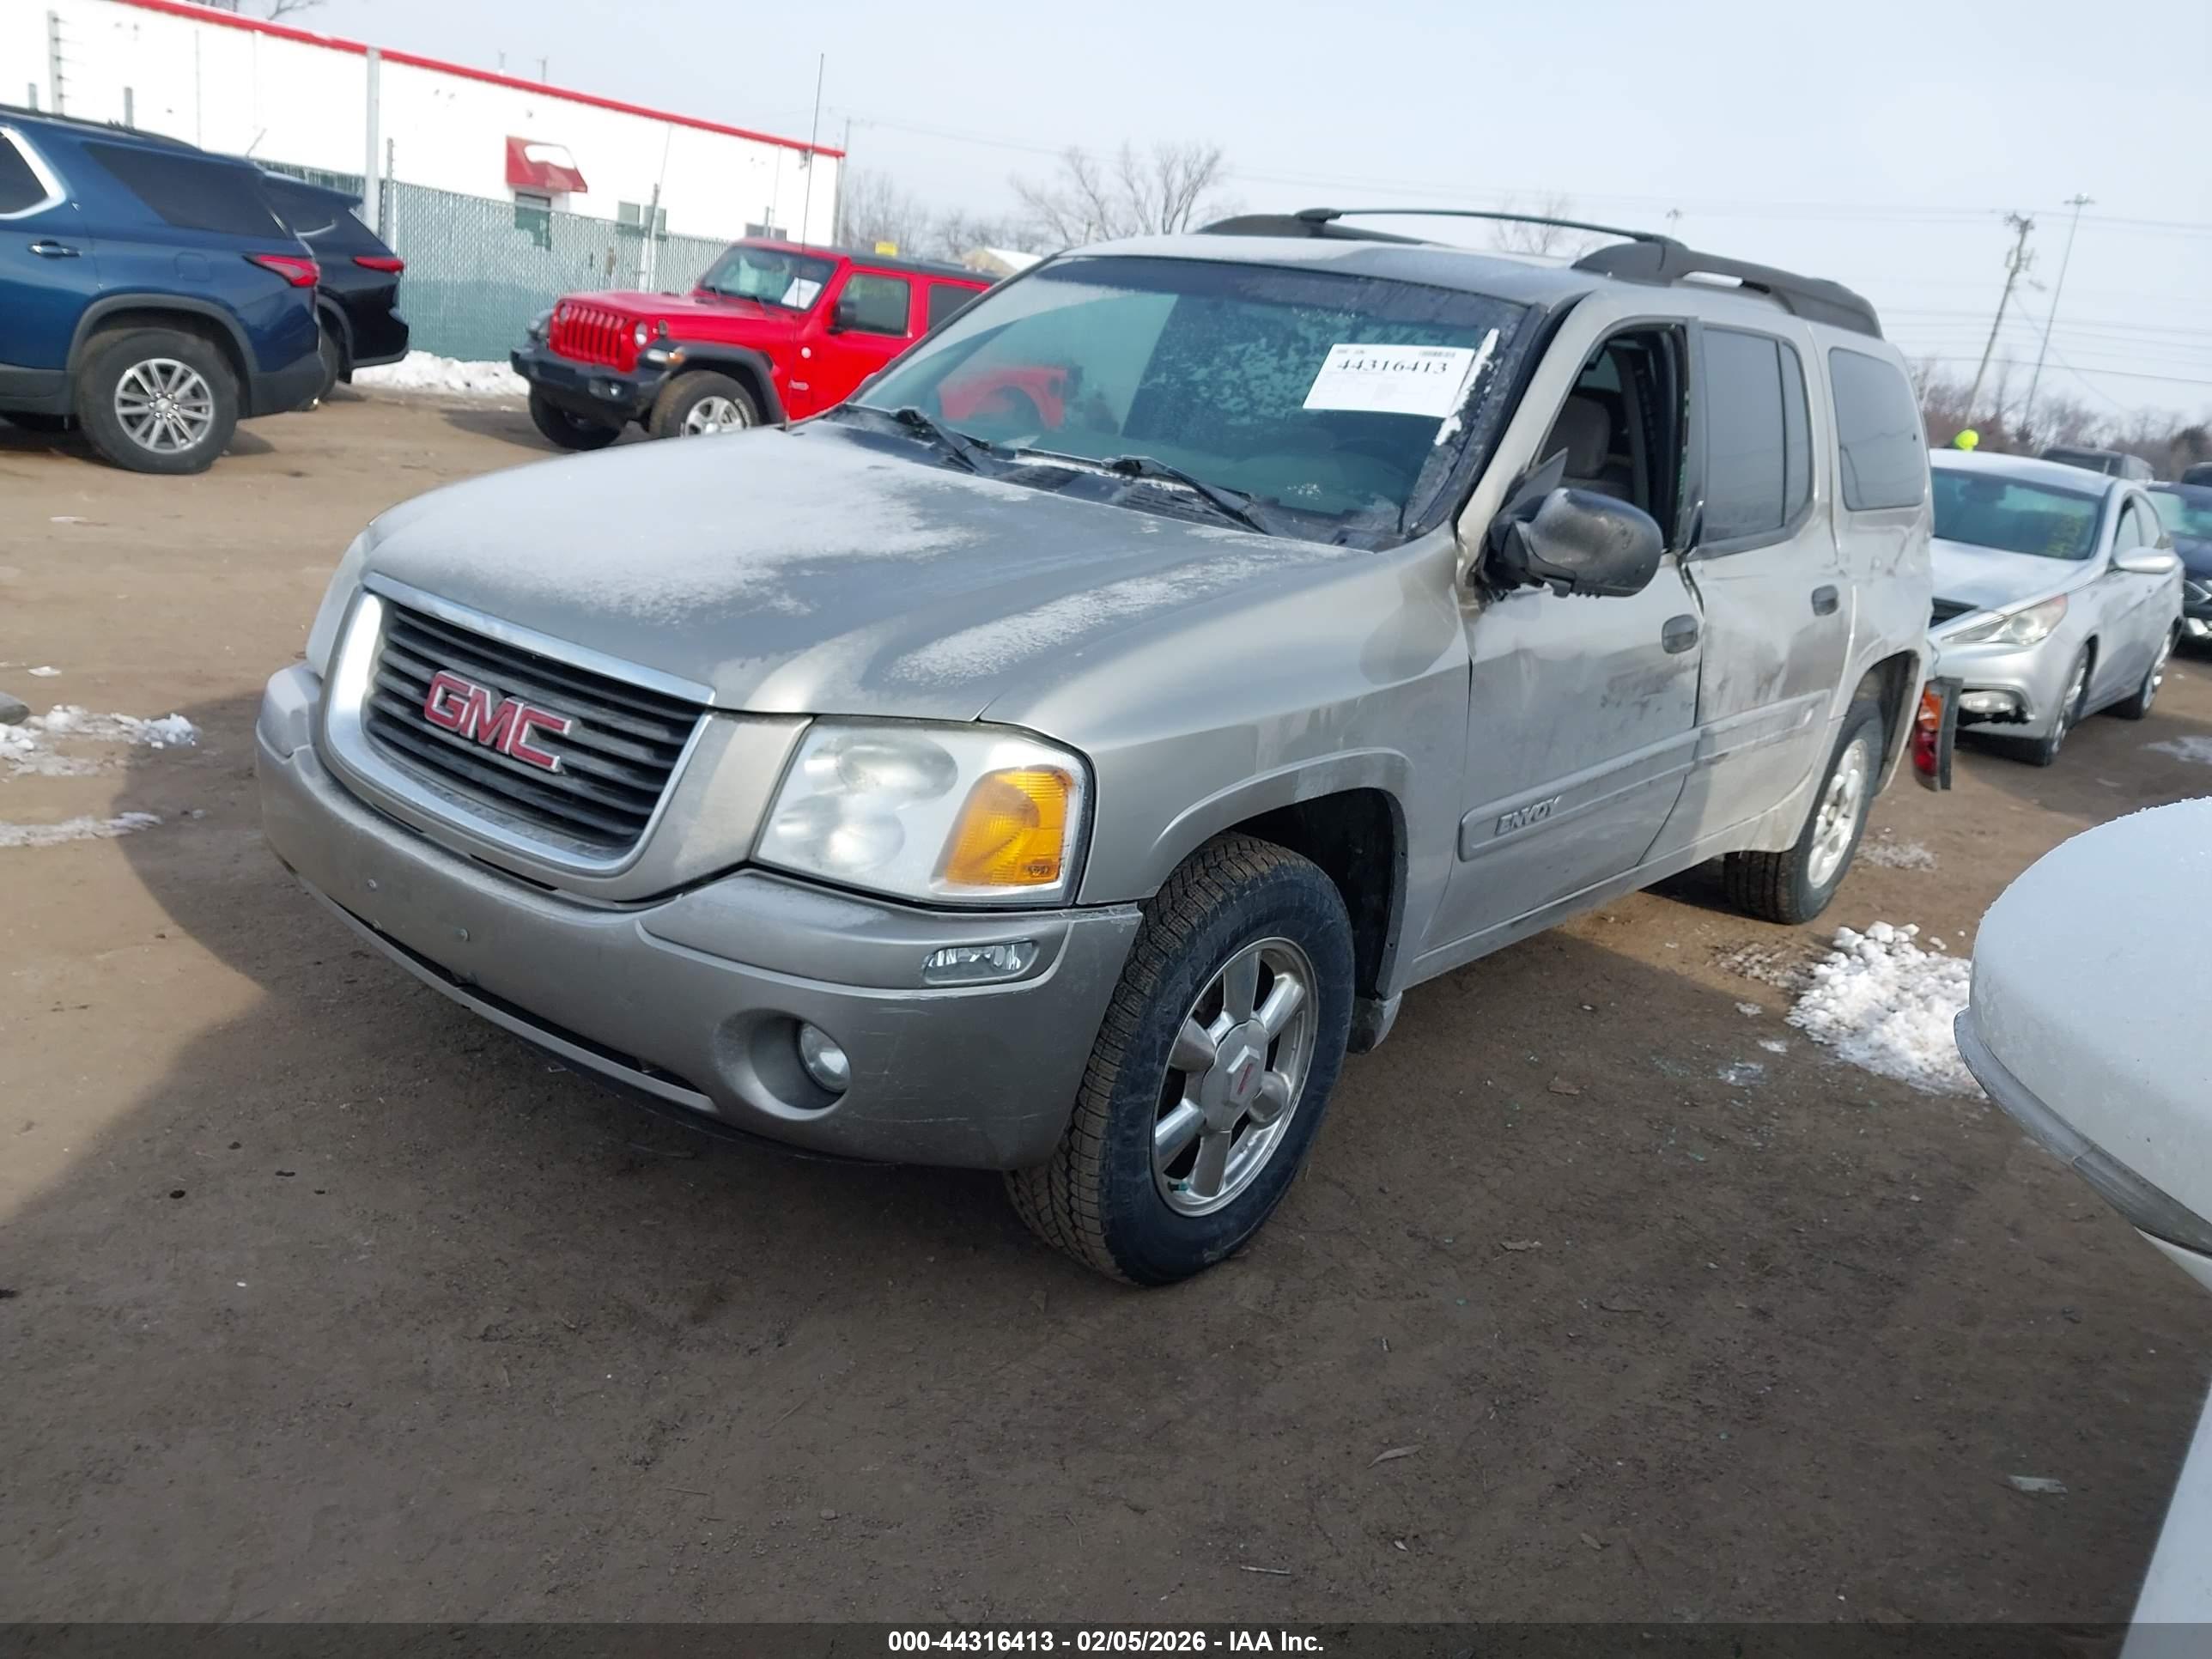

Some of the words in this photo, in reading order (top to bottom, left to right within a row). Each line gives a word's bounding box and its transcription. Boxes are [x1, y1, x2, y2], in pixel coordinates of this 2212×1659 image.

[1337, 359, 1448, 374] 44316413
[424, 670, 572, 773] GMC
[1494, 795, 1561, 836] ENVOY
